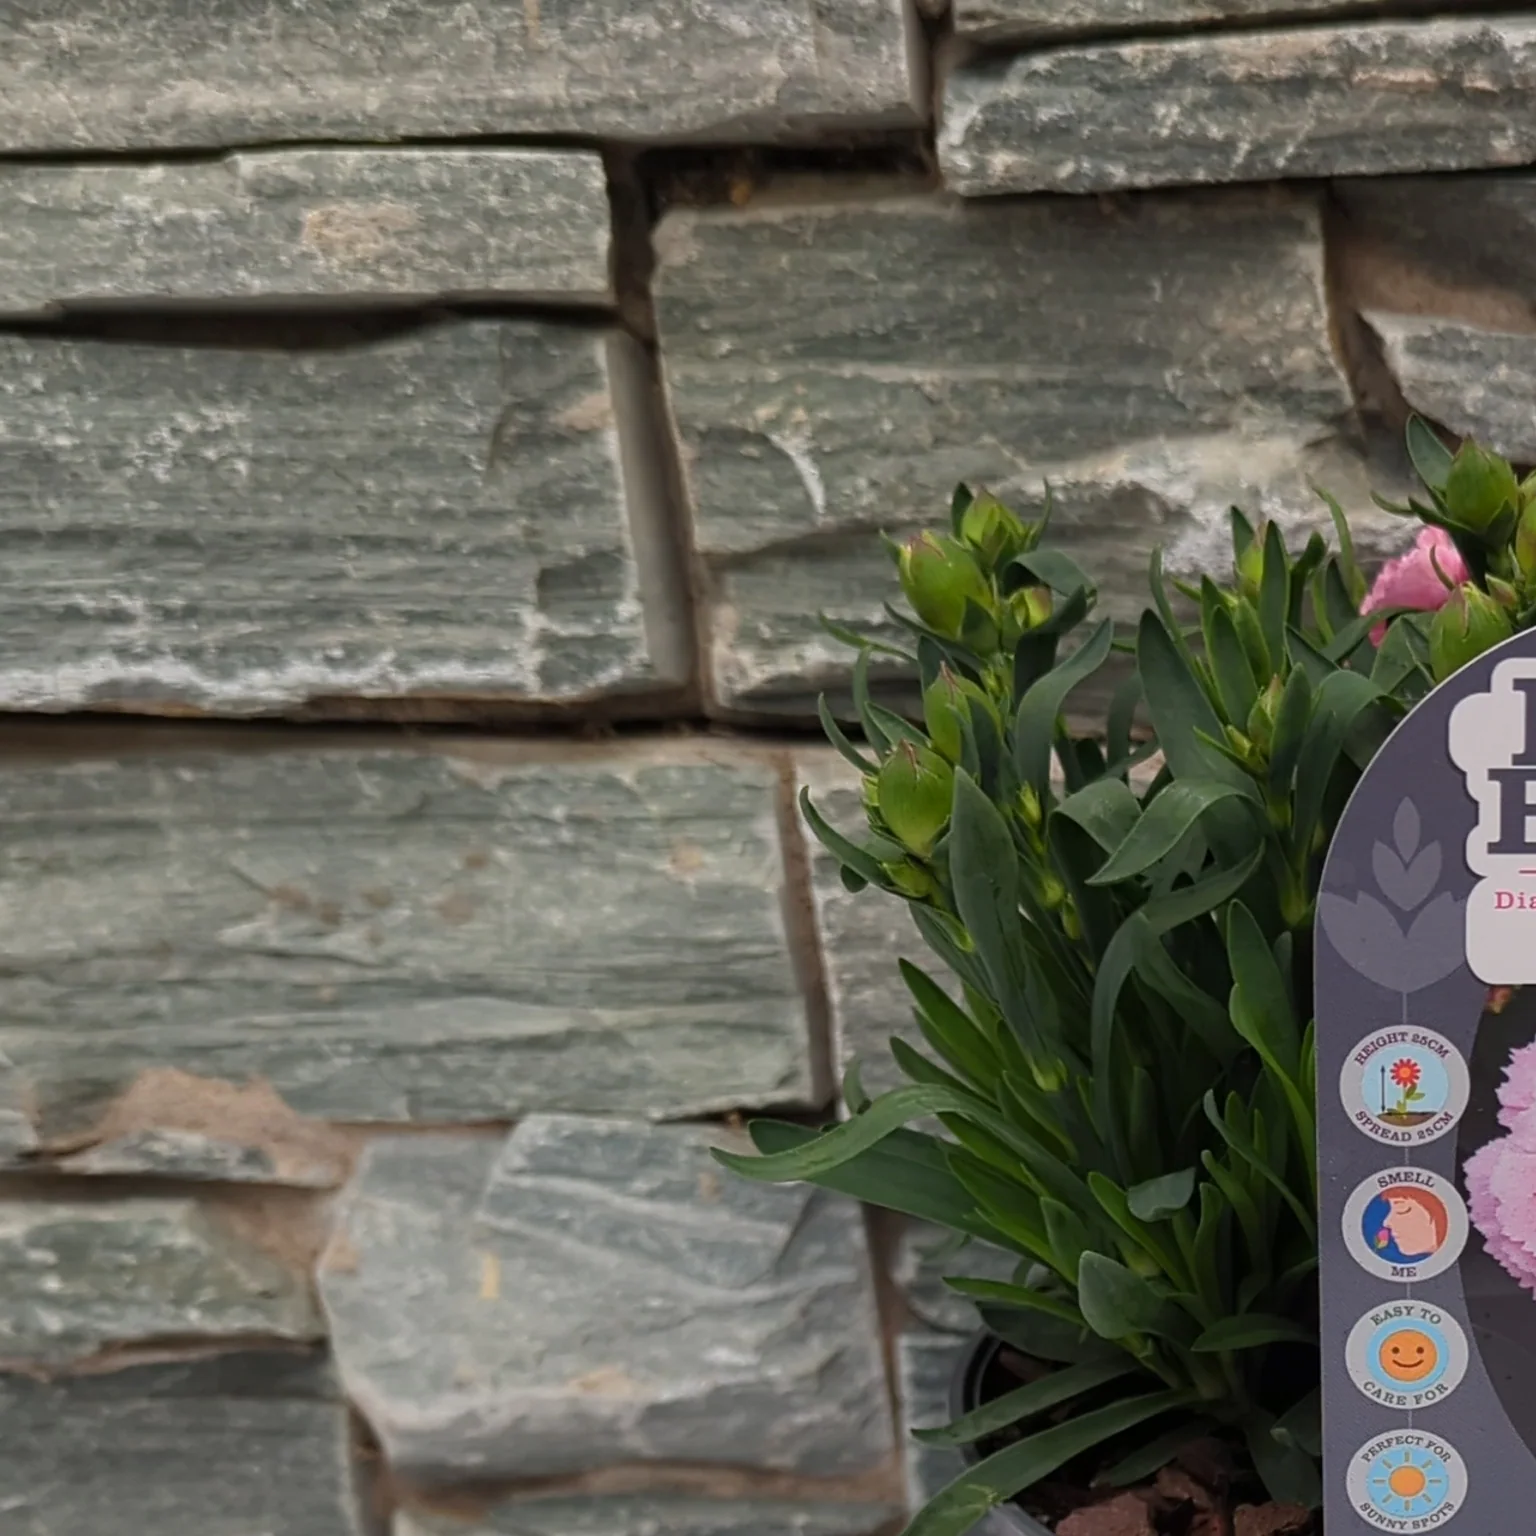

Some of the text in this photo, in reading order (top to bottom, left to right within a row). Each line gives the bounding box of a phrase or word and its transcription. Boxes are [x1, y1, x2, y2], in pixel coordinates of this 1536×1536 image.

[1353, 1032, 1409, 1066] HEIGHT
[1354, 1110, 1454, 1142] SPREAD 25CM
[1377, 1171, 1436, 1189] SMELL
[1391, 1266, 1417, 1278] ME
[1369, 1305, 1443, 1327] EASY TO
[1363, 1380, 1449, 1406] CARE FOR
[1361, 1435, 1453, 1463] PERFECT FOR
[1359, 1501, 1455, 1530] SUNNY SPOTS
